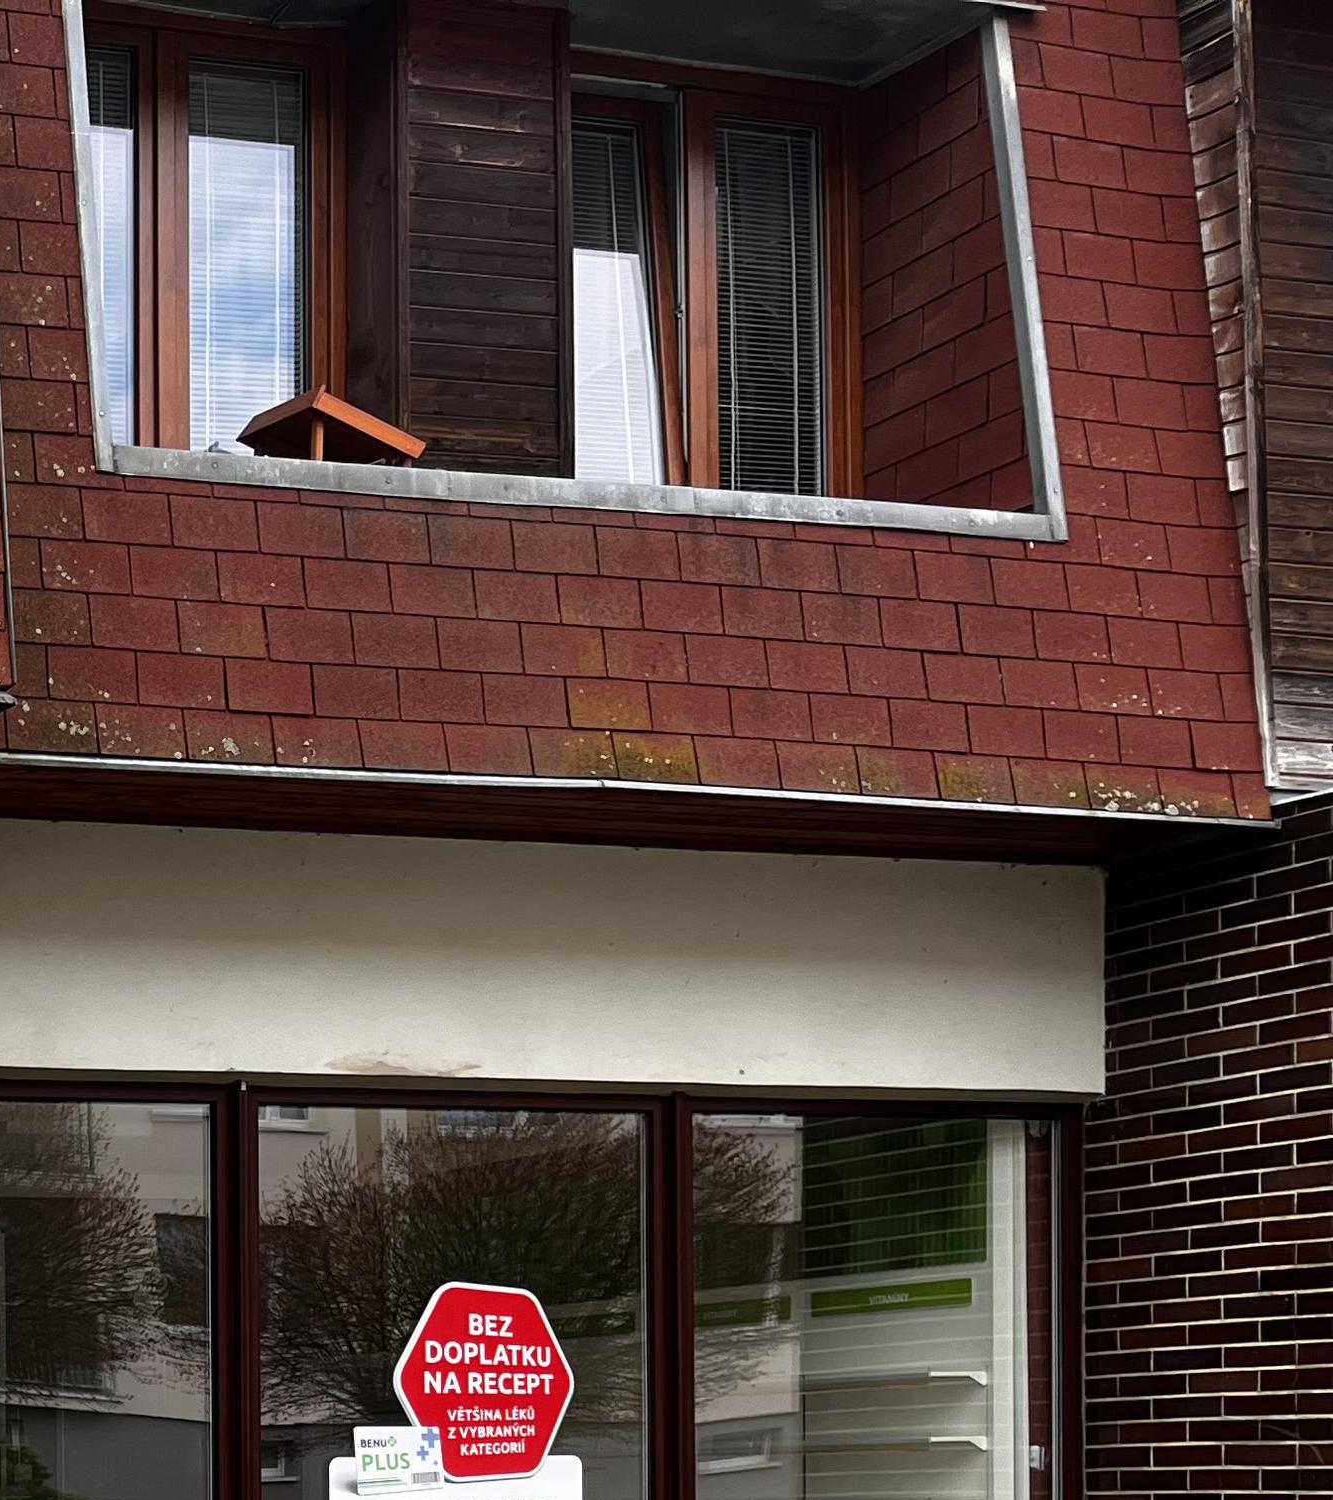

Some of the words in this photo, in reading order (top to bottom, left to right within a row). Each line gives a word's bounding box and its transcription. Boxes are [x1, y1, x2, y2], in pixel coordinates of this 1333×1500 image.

[468, 1313, 514, 1338] BEZ
[424, 1340, 551, 1368] DOPLATKU
[423, 1371, 462, 1395] NA
[467, 1372, 554, 1395] RECEPT
[447, 1406, 502, 1422] VĚTŠINA
[505, 1405, 536, 1421] LÉKŮ
[447, 1427, 457, 1439] Z
[459, 1422, 536, 1439] VYBRANÝCH
[360, 1438, 387, 1448] BENU
[460, 1439, 526, 1456] KATEGORIÍ
[361, 1452, 411, 1472] PLUS
